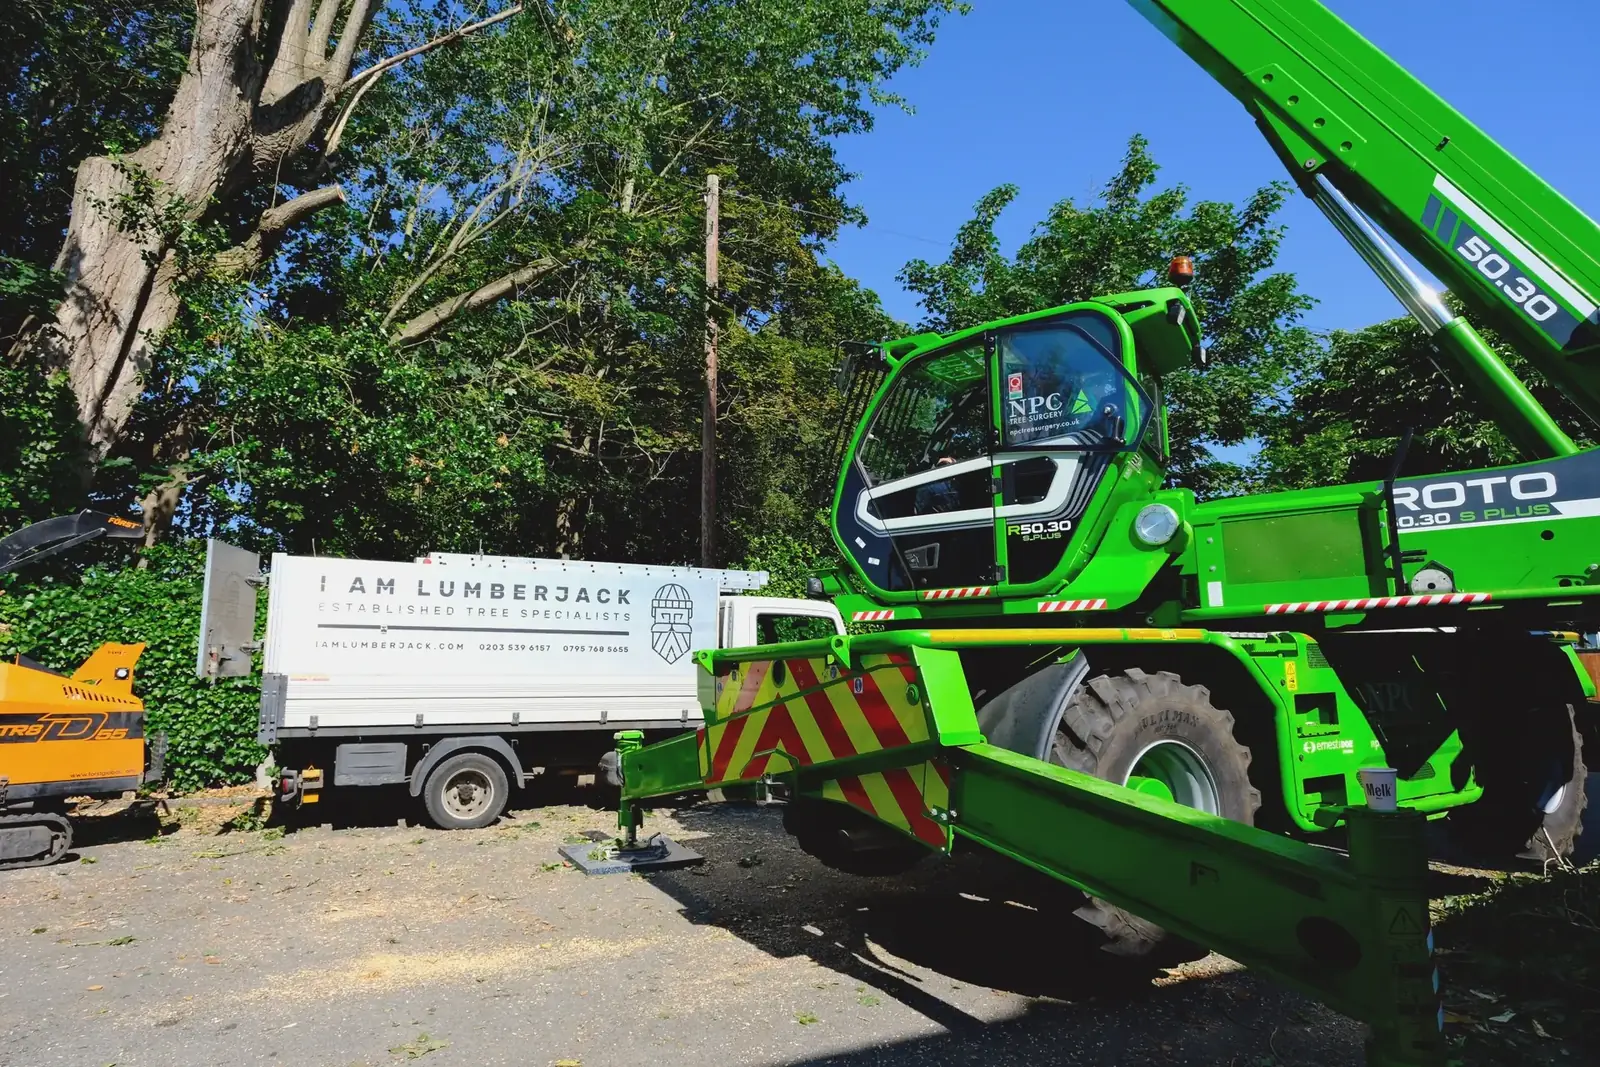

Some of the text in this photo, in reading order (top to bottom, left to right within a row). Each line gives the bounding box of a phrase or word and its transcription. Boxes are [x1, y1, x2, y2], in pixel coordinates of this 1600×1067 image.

[1457, 236, 1558, 321] 50.30
[1009, 392, 1063, 418] NPC
[1009, 410, 1063, 425] TREE SURGERY
[1392, 471, 1557, 511] ROTO
[1396, 503, 1551, 528] 0.30 S PLUS
[1007, 520, 1072, 536] R50.30
[320, 575, 631, 605] I AM LUMBERJACK
[318, 602, 631, 622] ESTABLISHED TREE SPECIALISTS
[315, 641, 464, 650] IAMLUMBERJACK.COM
[479, 643, 505, 651] 0203
[528, 644, 551, 652] 6157
[1365, 783, 1392, 797] Melk
